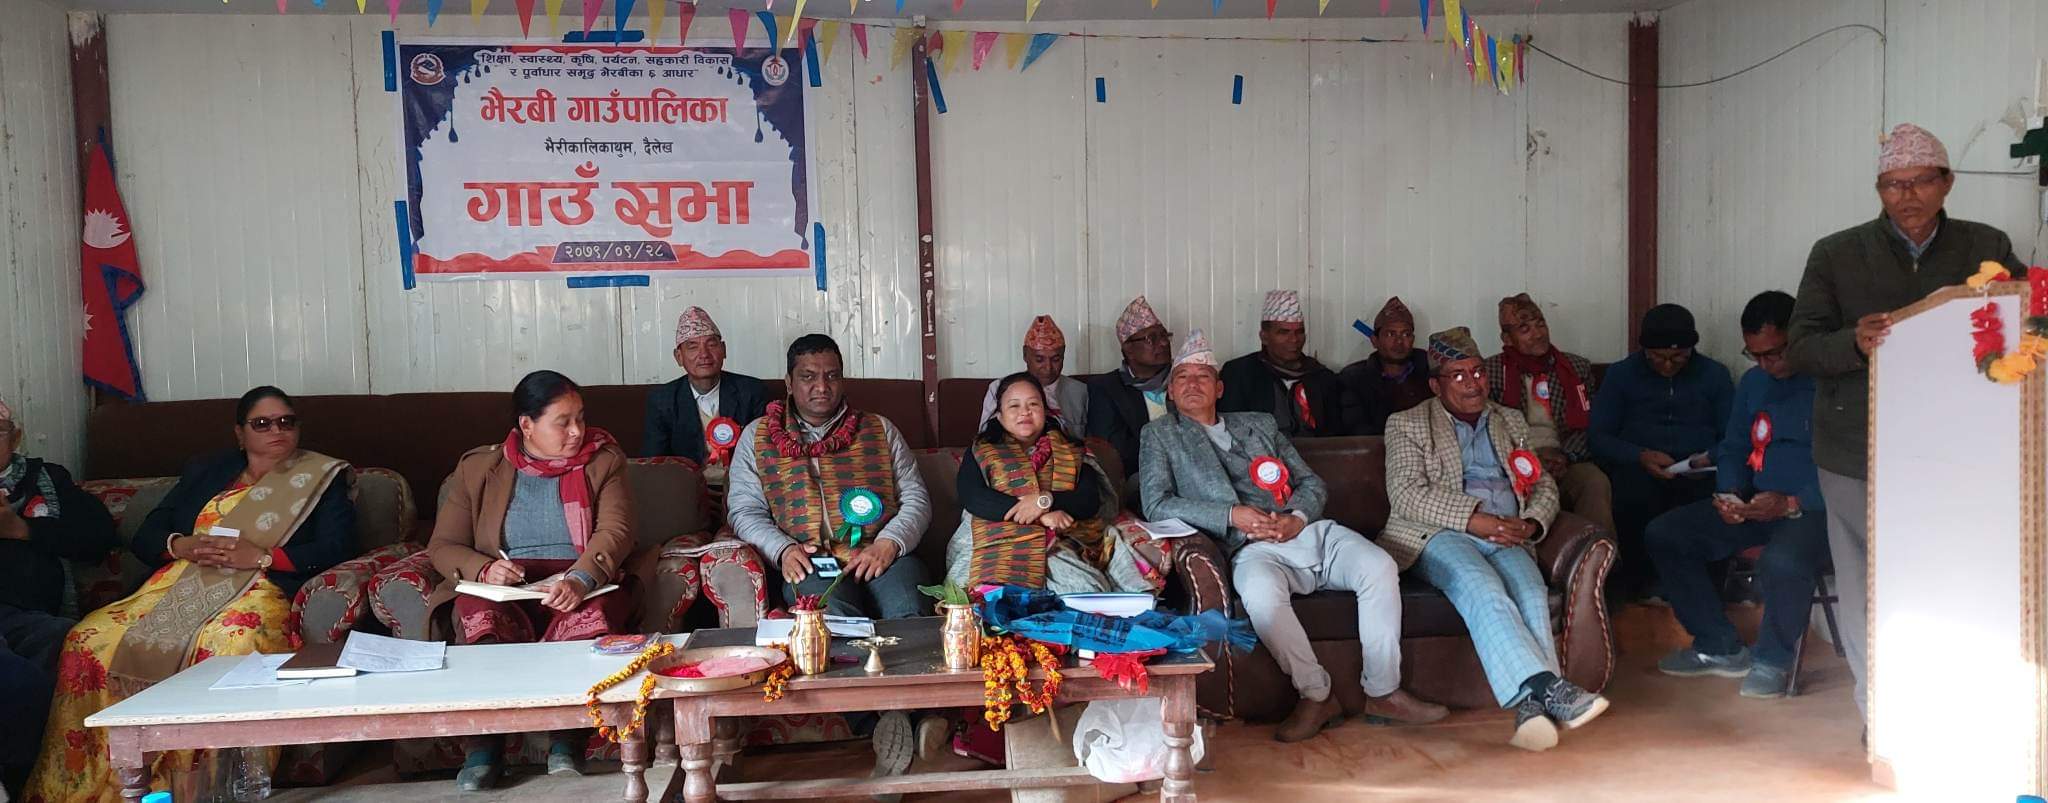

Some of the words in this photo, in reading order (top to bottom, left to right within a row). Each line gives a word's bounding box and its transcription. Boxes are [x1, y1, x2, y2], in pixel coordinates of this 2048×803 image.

[645, 54, 689, 66] सहकारी
[509, 68, 517, 77] र
[522, 67, 562, 80] पूर्वाधार
[480, 86, 557, 124] भैरबी
[567, 88, 729, 125] गाउँपालिका
[642, 137, 673, 154] दैलेख
[464, 160, 600, 227] गाउँ
[611, 181, 754, 239] सभा
[565, 242, 664, 258] २०७९/०९/२८
